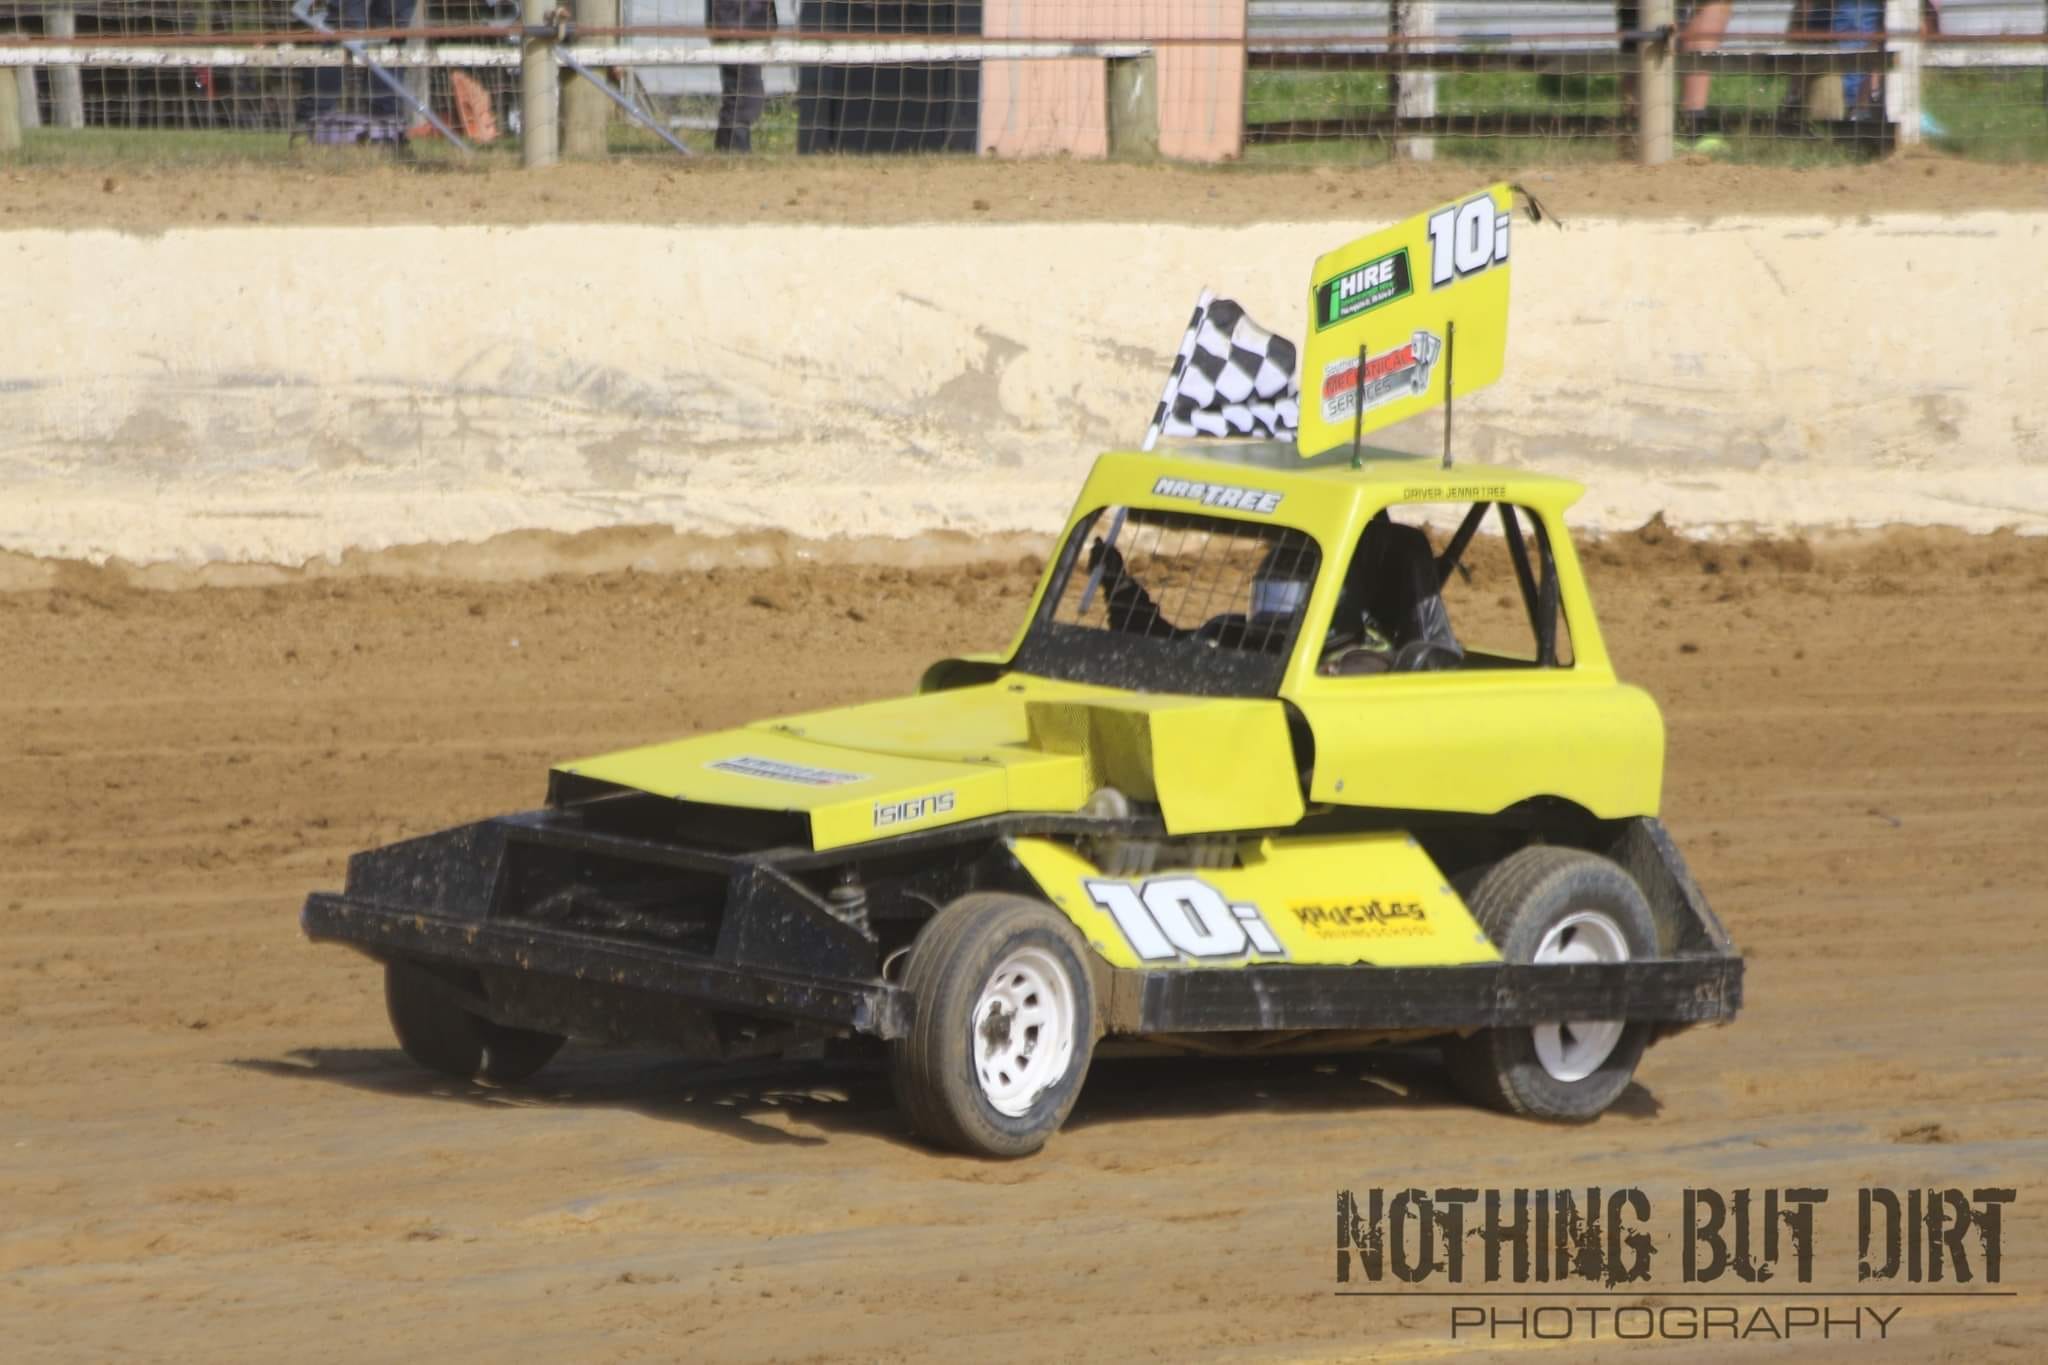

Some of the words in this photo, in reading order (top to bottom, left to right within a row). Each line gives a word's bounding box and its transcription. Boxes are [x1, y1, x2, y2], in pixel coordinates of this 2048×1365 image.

[1428, 194, 1510, 289] 10i
[1327, 352, 1409, 395] MECANICAL
[1327, 379, 1392, 416] SERICES
[1084, 875, 1287, 962] 10i
